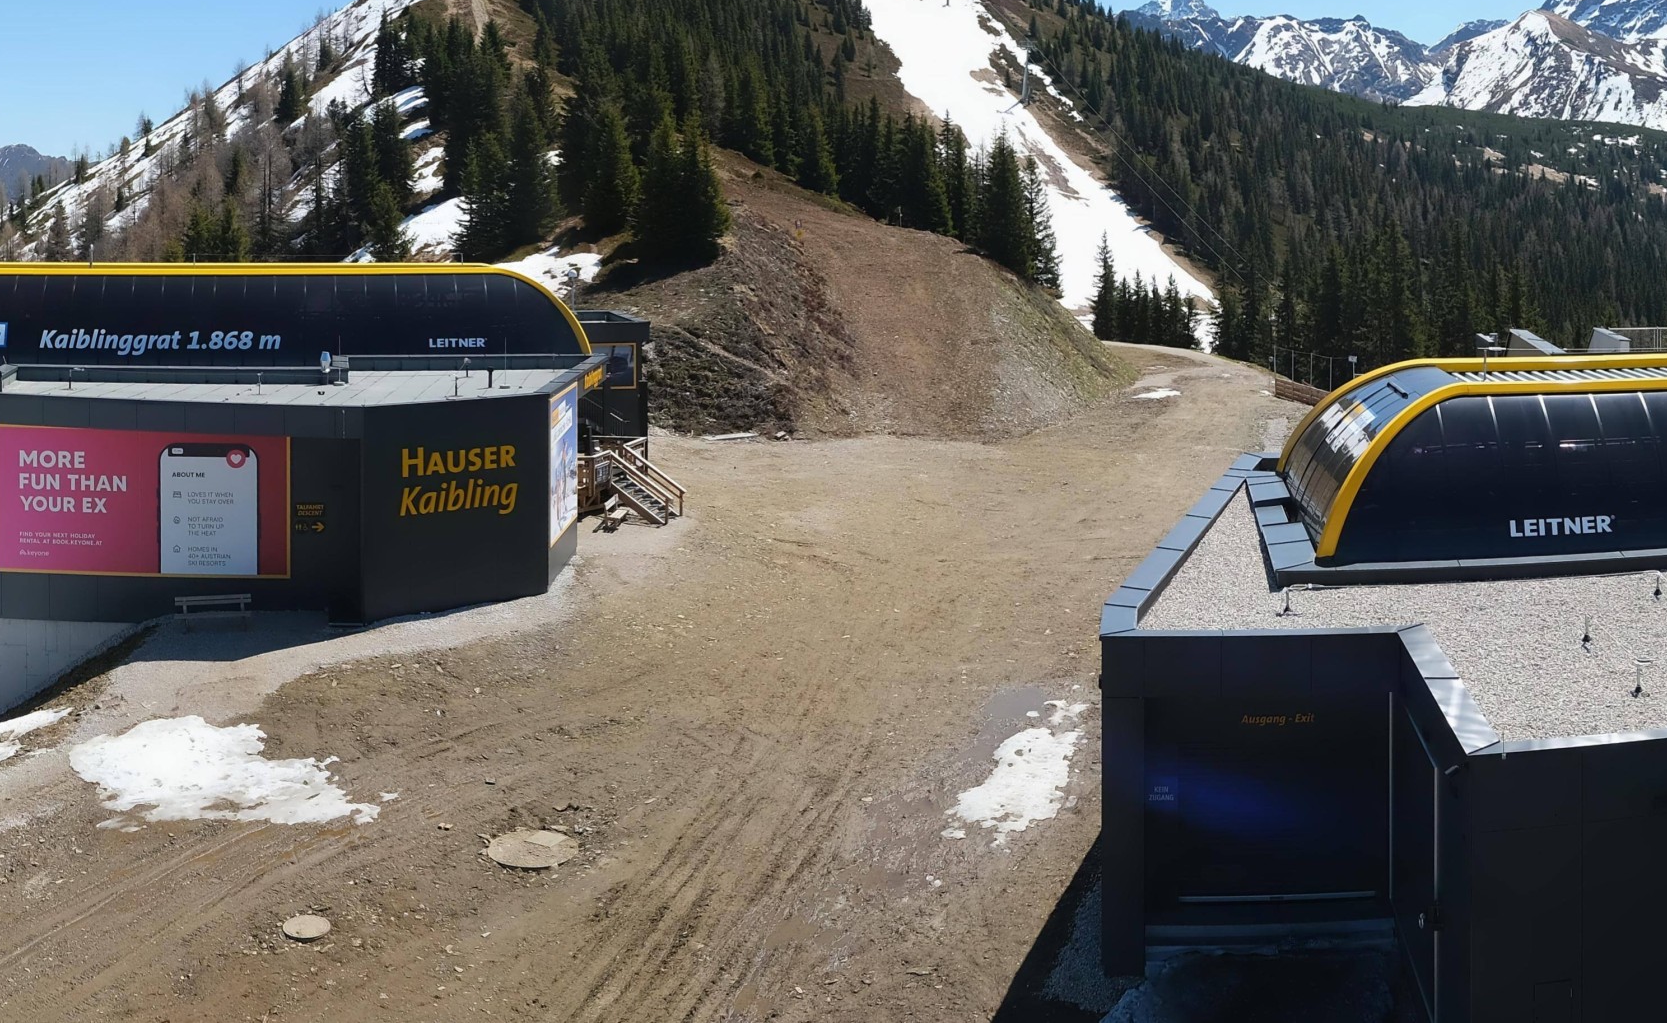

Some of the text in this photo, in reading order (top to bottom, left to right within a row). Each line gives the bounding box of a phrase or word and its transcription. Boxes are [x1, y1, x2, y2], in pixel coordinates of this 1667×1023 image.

[39, 328, 282, 356] Kaiblinggrat 1.868 m
[428, 337, 487, 349] LEITNER
[19, 449, 86, 469] MORE
[401, 444, 517, 478] HAUSER
[19, 473, 127, 492] FUN THAN
[20, 495, 107, 514] YOUR EX
[400, 478, 519, 517] Kaibling
[1509, 515, 1613, 538] LEITNER
[1240, 714, 1286, 726] Ausgang
[1294, 712, 1315, 723] Exit
